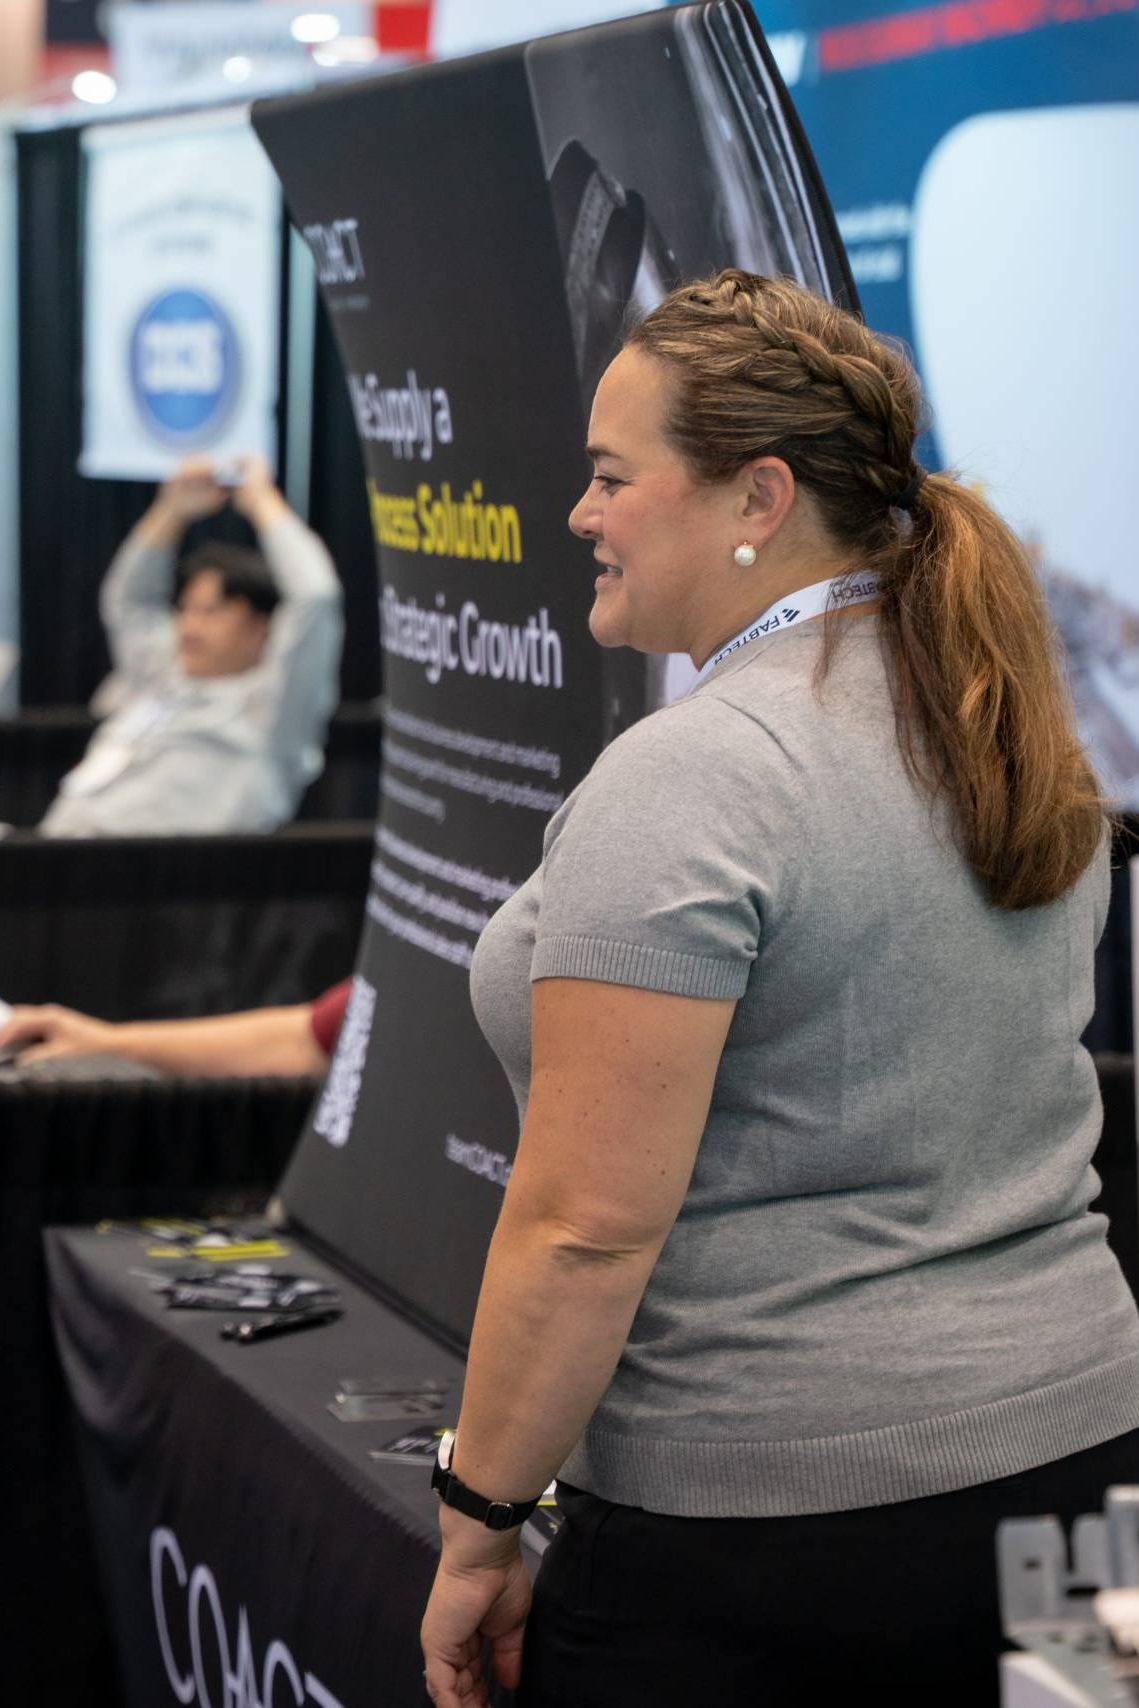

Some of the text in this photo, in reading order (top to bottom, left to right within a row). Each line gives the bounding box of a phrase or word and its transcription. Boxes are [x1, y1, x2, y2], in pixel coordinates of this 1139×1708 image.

[432, 387, 454, 444] a
[416, 479, 523, 564] Solution
[459, 601, 563, 689] Growth
[714, 615, 781, 666] FABTECH
